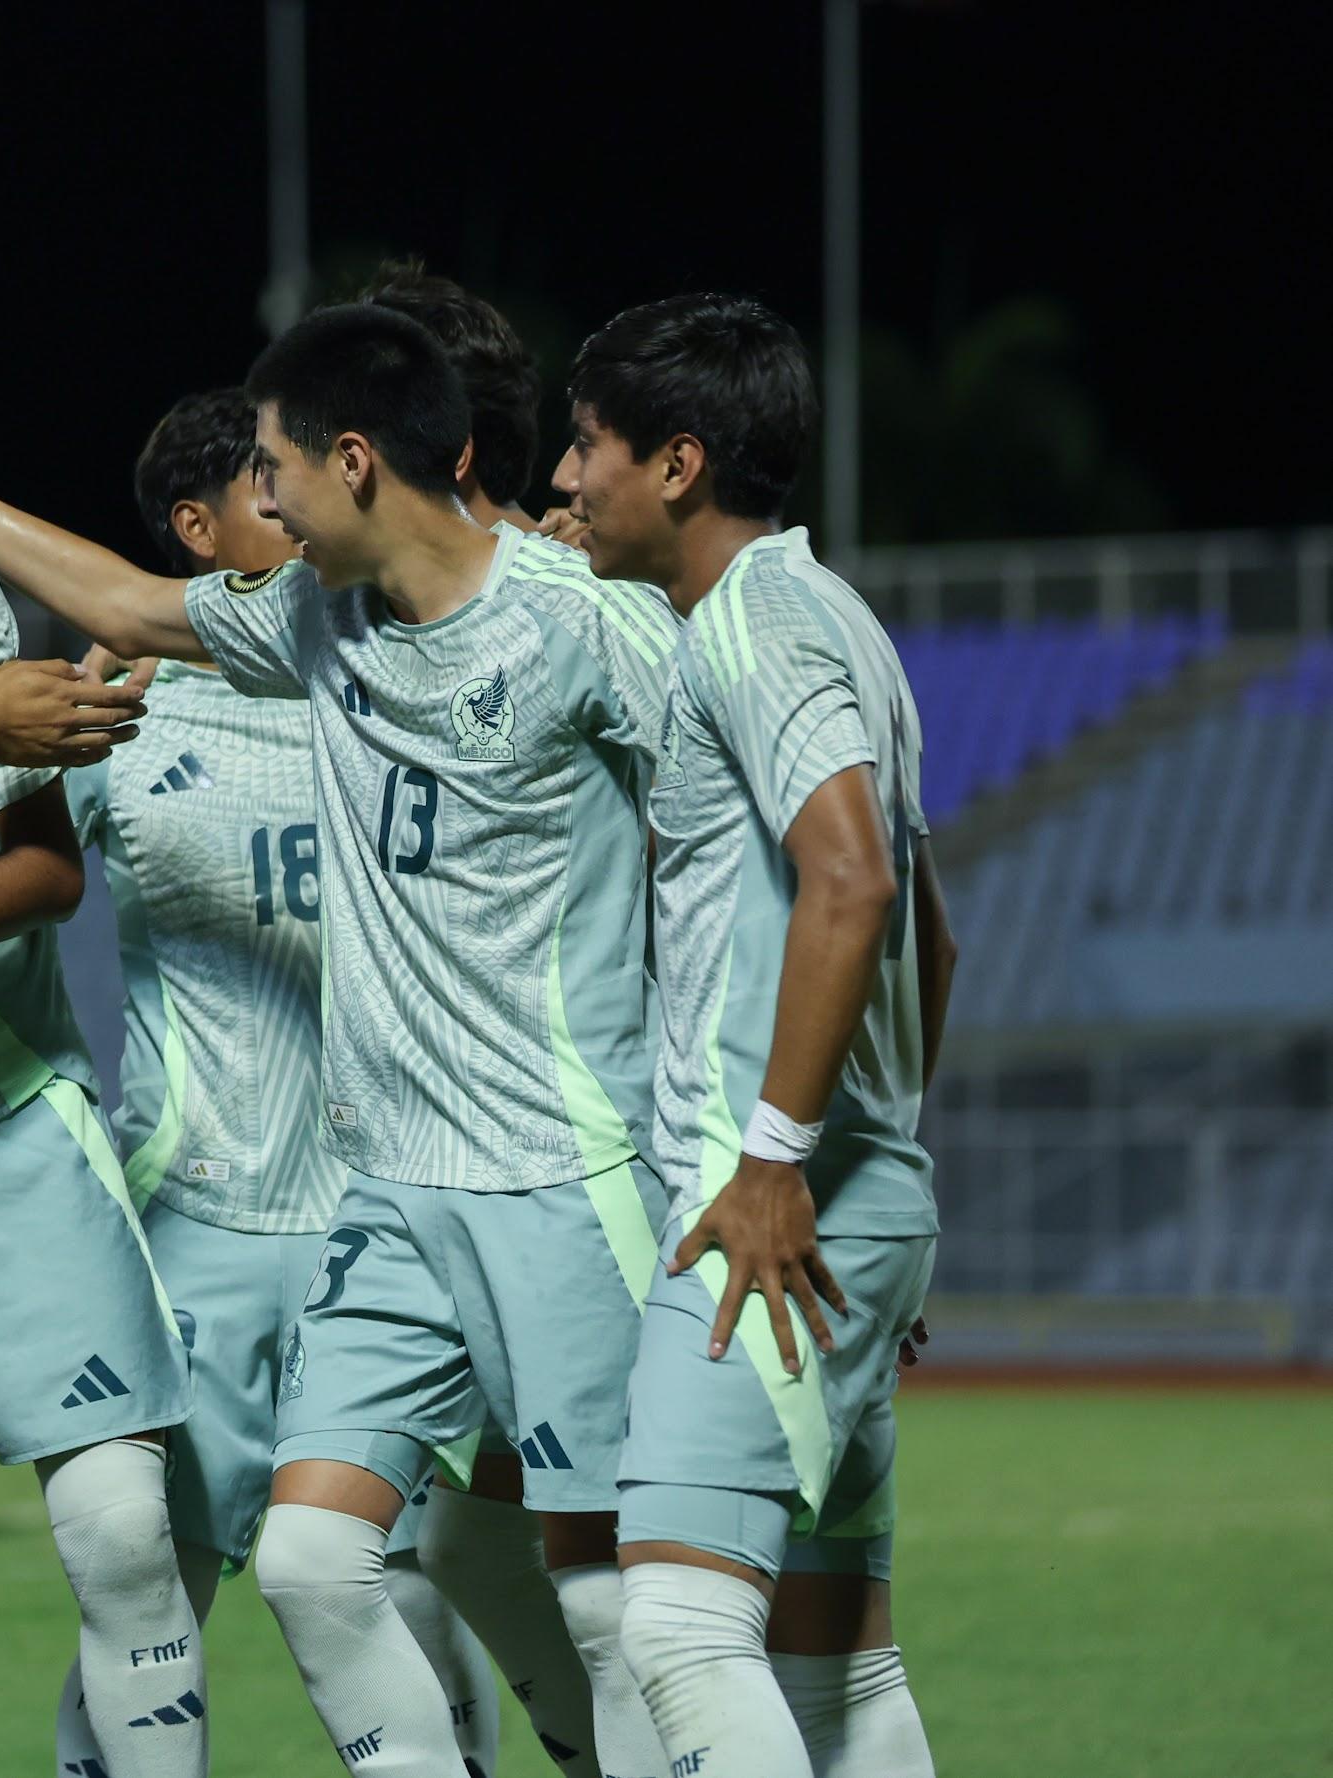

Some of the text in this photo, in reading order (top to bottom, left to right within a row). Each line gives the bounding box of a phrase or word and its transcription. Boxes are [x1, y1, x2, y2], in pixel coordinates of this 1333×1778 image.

[459, 743, 513, 760] MÉXICO
[378, 764, 438, 875] 13
[252, 823, 320, 926] 18
[130, 1634, 190, 1667] FMF
